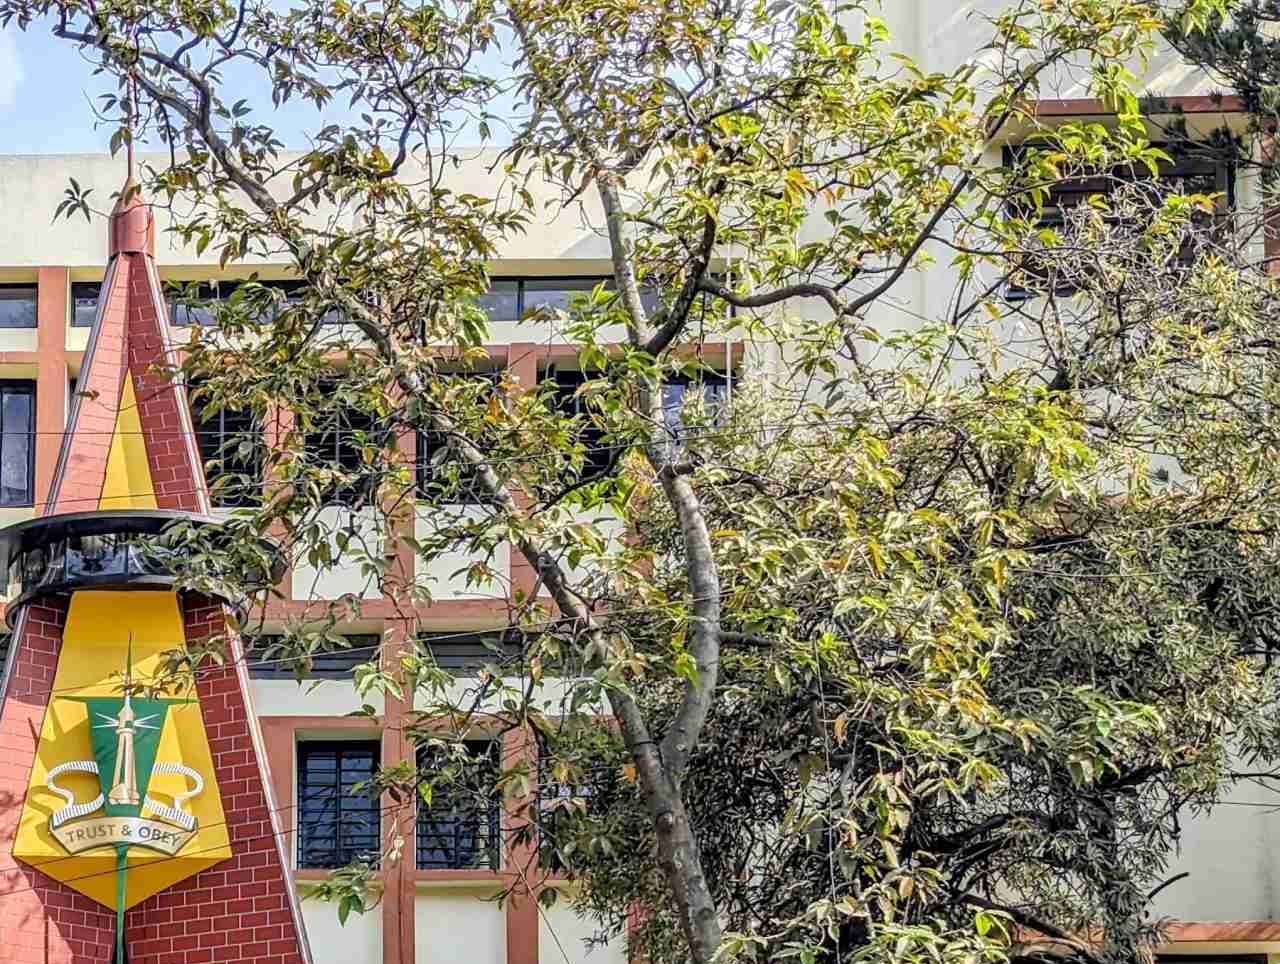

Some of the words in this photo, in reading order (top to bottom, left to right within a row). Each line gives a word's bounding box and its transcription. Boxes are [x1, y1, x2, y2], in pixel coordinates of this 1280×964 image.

[65, 824, 116, 843] TRUST
[121, 825, 132, 836] &
[138, 826, 182, 847] OBEY
